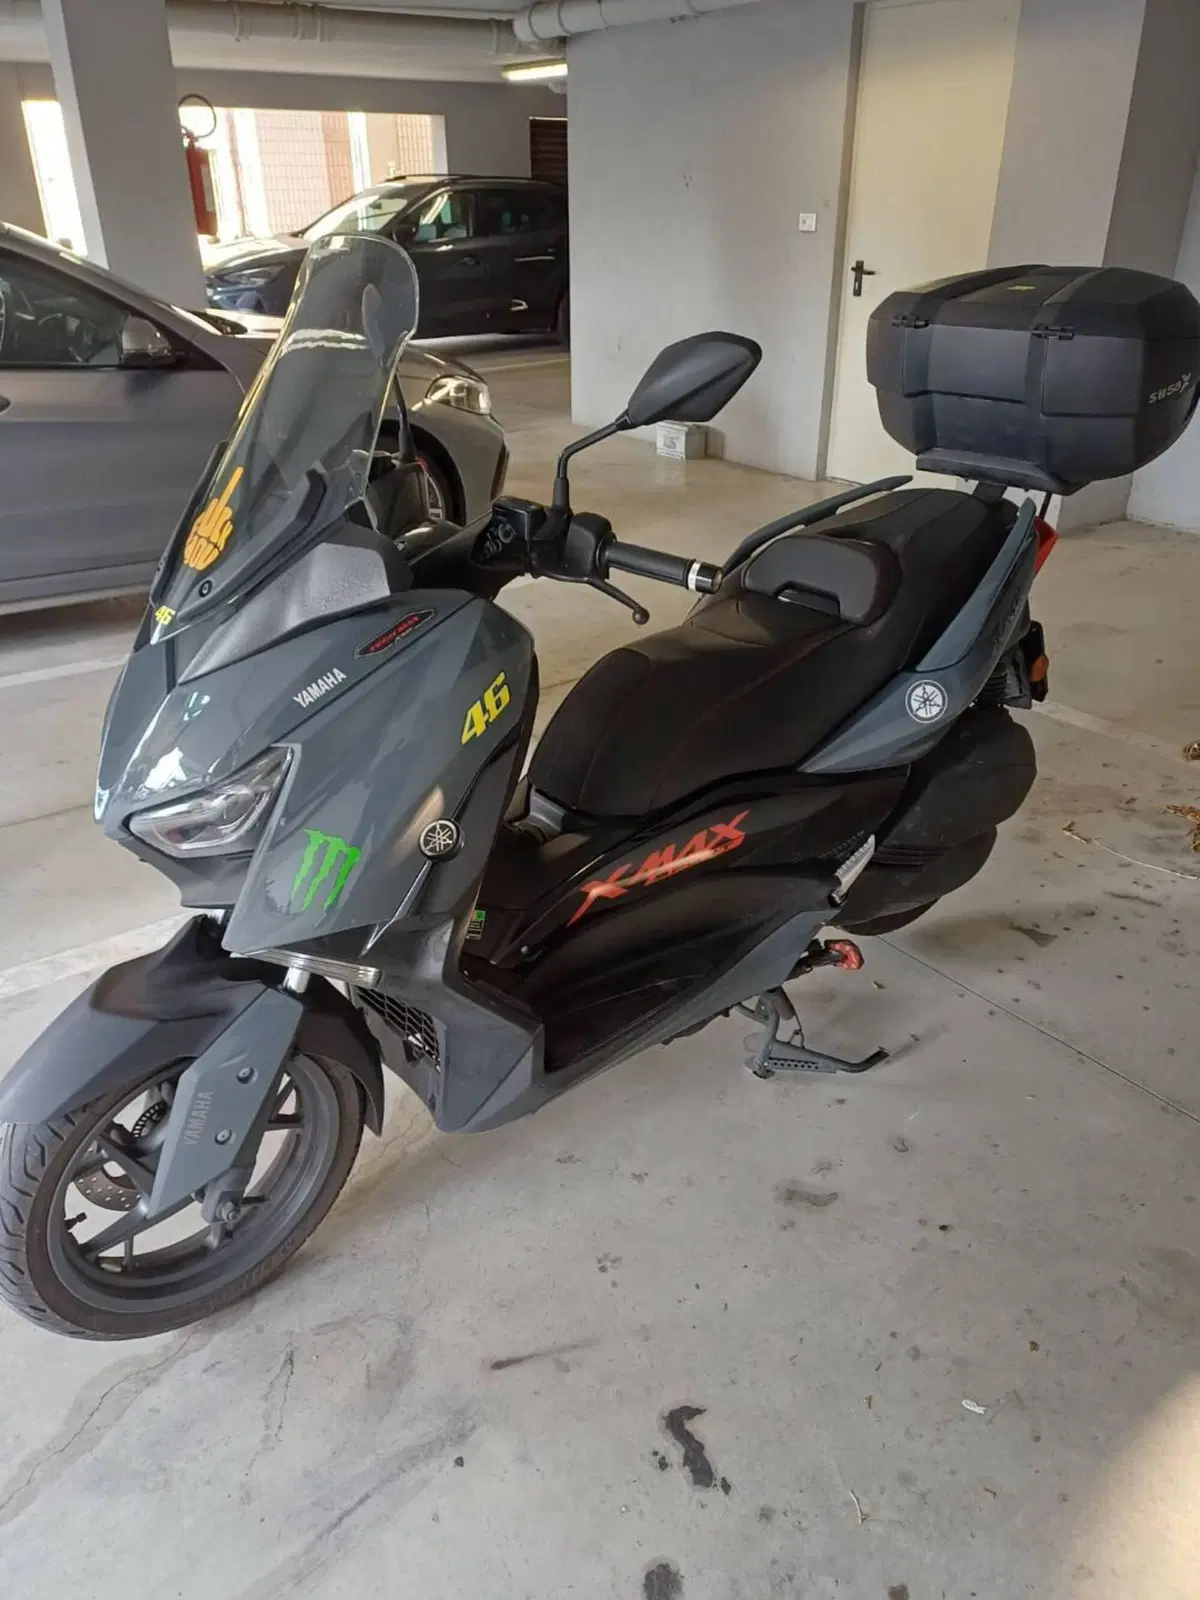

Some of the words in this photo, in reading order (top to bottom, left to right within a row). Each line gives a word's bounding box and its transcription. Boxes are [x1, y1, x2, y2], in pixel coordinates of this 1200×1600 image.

[154, 605, 177, 626] 46
[293, 667, 348, 708] YAMAHA
[461, 671, 511, 745] 46
[183, 1091, 215, 1145] YAMAHA
